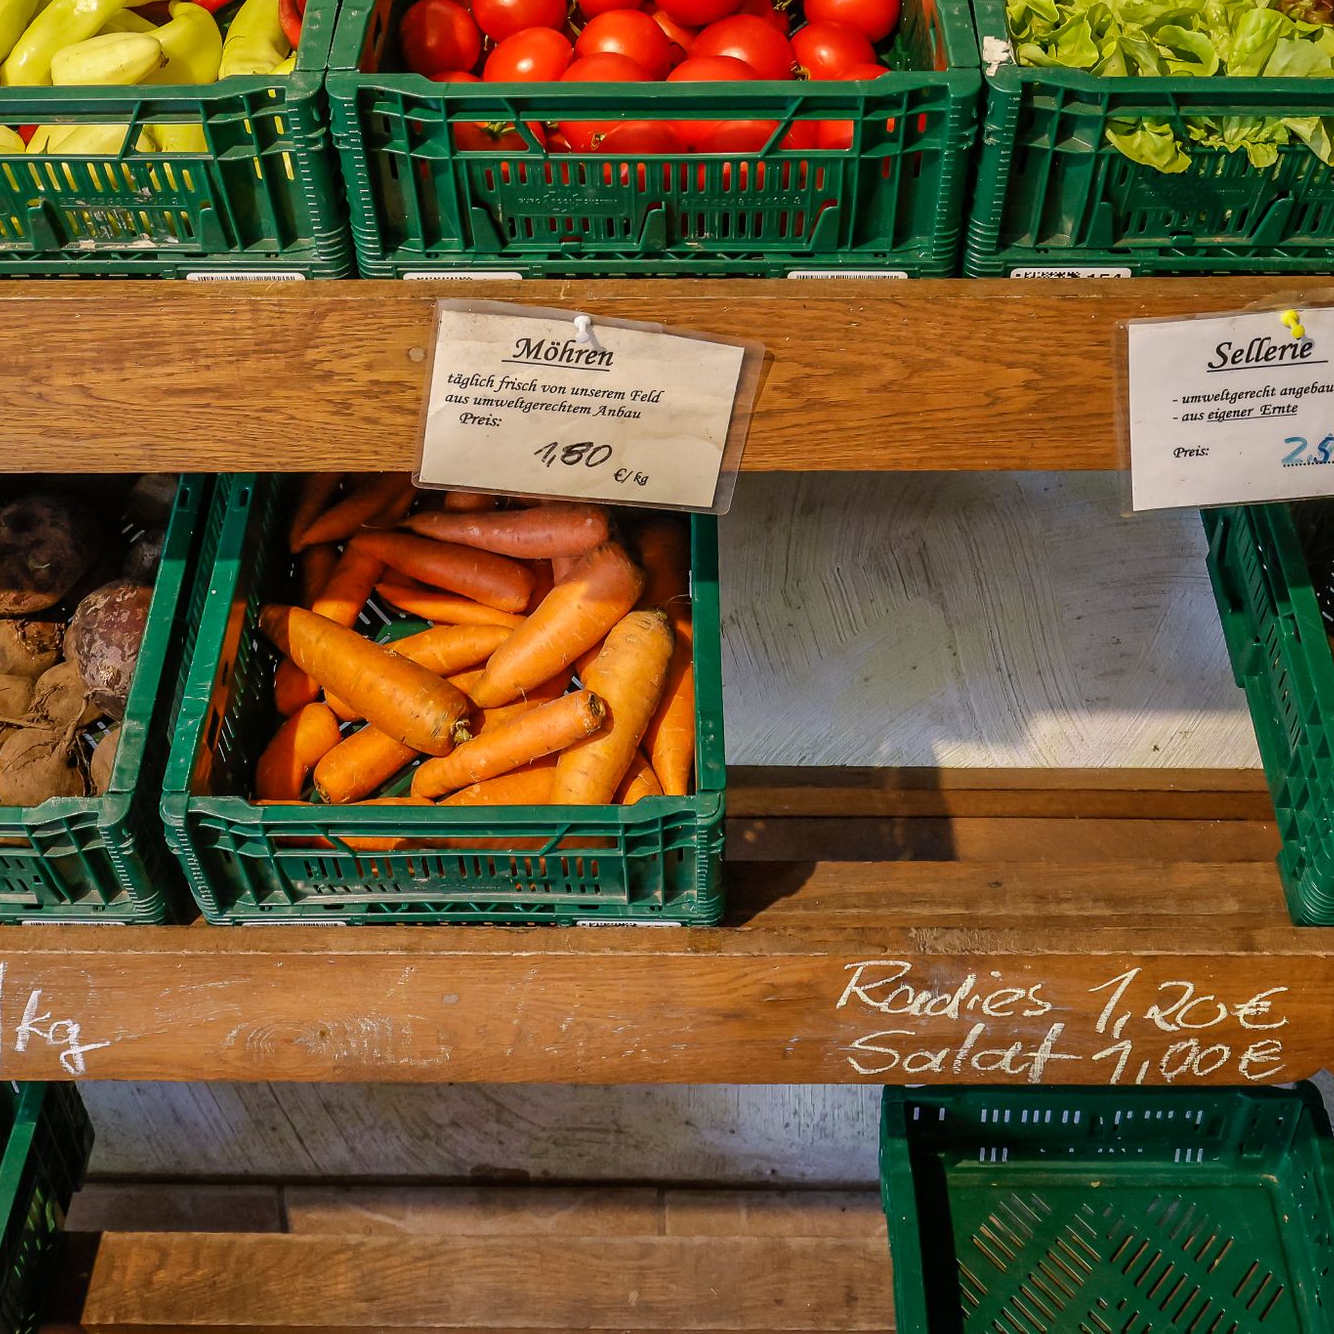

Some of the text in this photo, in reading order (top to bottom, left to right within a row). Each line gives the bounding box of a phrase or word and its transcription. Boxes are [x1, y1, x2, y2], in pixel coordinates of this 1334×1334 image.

[513, 337, 614, 367] Möhren
[1207, 336, 1314, 369] Sellerie
[448, 373, 665, 404] täglich frisch von unserem Feld
[1181, 385, 1276, 406] umweltgerecht
[445, 393, 642, 419] aus umweltgerechtem Anbau
[460, 412, 504, 427] Preis:
[1181, 410, 1204, 422] aus
[1207, 407, 1254, 423] eigener
[1259, 403, 1298, 416] Ernte
[1173, 446, 1210, 459] Preis:
[835, 959, 1290, 1040] Radies 1,20€
[846, 1021, 1083, 1085] Salat
